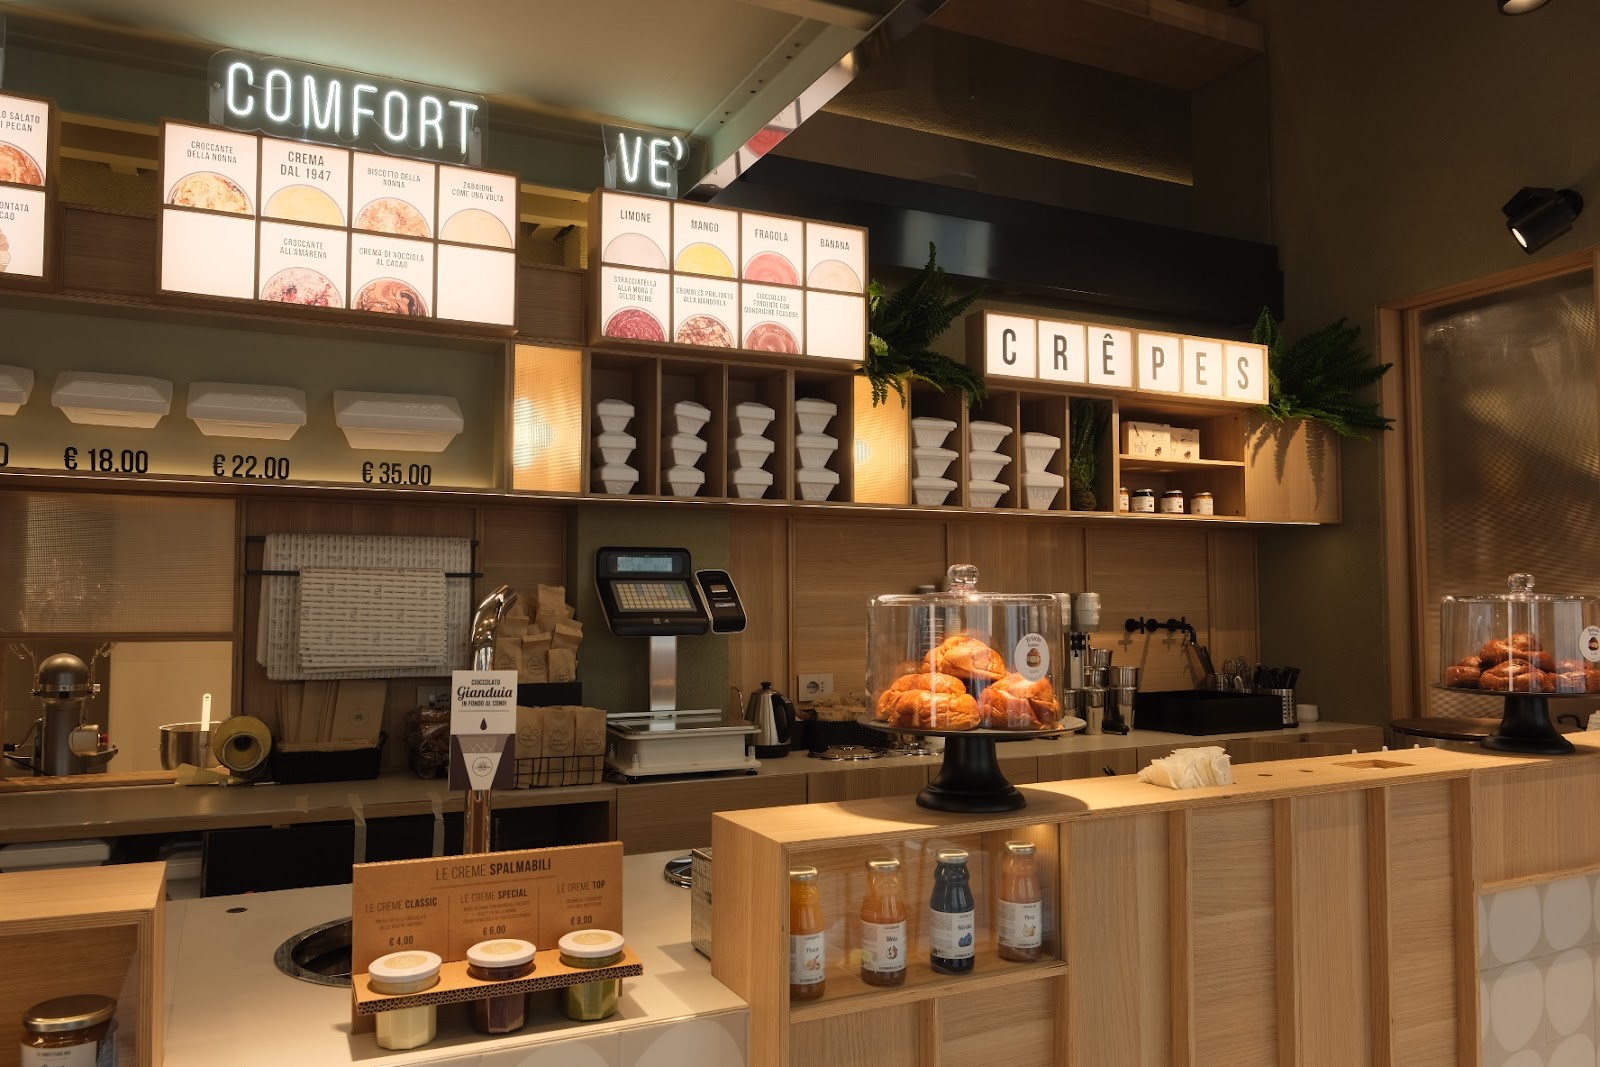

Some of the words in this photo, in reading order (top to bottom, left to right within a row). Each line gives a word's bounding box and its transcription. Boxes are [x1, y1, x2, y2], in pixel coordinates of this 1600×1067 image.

[227, 61, 479, 154] COMFORT
[10, 112, 40, 124] SALATO
[6, 121, 32, 132] PECAN
[190, 140, 234, 154] CROCCANTE
[186, 149, 210, 160] DELLA
[212, 152, 237, 164] NONNA
[288, 150, 324, 166] CREMA
[280, 164, 300, 178] DAL
[306, 168, 332, 182] 1947
[367, 167, 399, 180] BISCOTTO
[400, 172, 421, 183] DELLA
[382, 178, 406, 189] NONNA
[452, 188, 469, 198] COME
[485, 192, 504, 202] VOLTA
[620, 208, 652, 224] LIMONE
[690, 219, 720, 233] MANGO
[754, 228, 788, 242] FRAGOLA
[283, 238, 324, 250] CROCCANTE
[820, 238, 850, 251] BANANA
[359, 247, 382, 258] CREMA
[384, 250, 391, 258] DI
[392, 251, 424, 262] NOCCIOLA
[376, 258, 384, 266] AL
[386, 259, 408, 268] CACAO
[1002, 328, 1250, 390] CRÊPES
[64, 446, 78, 470] €
[88, 448, 148, 474] 18.00
[212, 454, 226, 477] €
[232, 454, 290, 480] 22.00
[362, 461, 374, 484] €
[378, 462, 432, 486] 35.00
[457, 686, 512, 701] Gianduia
[436, 868, 448, 880] LE
[452, 864, 486, 880] CREME
[490, 858, 552, 876] SPALMABILI
[557, 884, 565, 894] LE
[568, 882, 590, 892] CREME
[592, 880, 606, 890] TOP
[460, 894, 471, 903] LE
[471, 891, 496, 902] CREME
[497, 888, 528, 899] SPECIAL
[365, 904, 374, 913] LE
[377, 901, 402, 912] CREME
[405, 897, 438, 909] CLASSIC
[570, 917, 576, 925] €
[483, 927, 487, 935] €
[390, 938, 394, 946] €
[396, 936, 414, 946] 4,00
